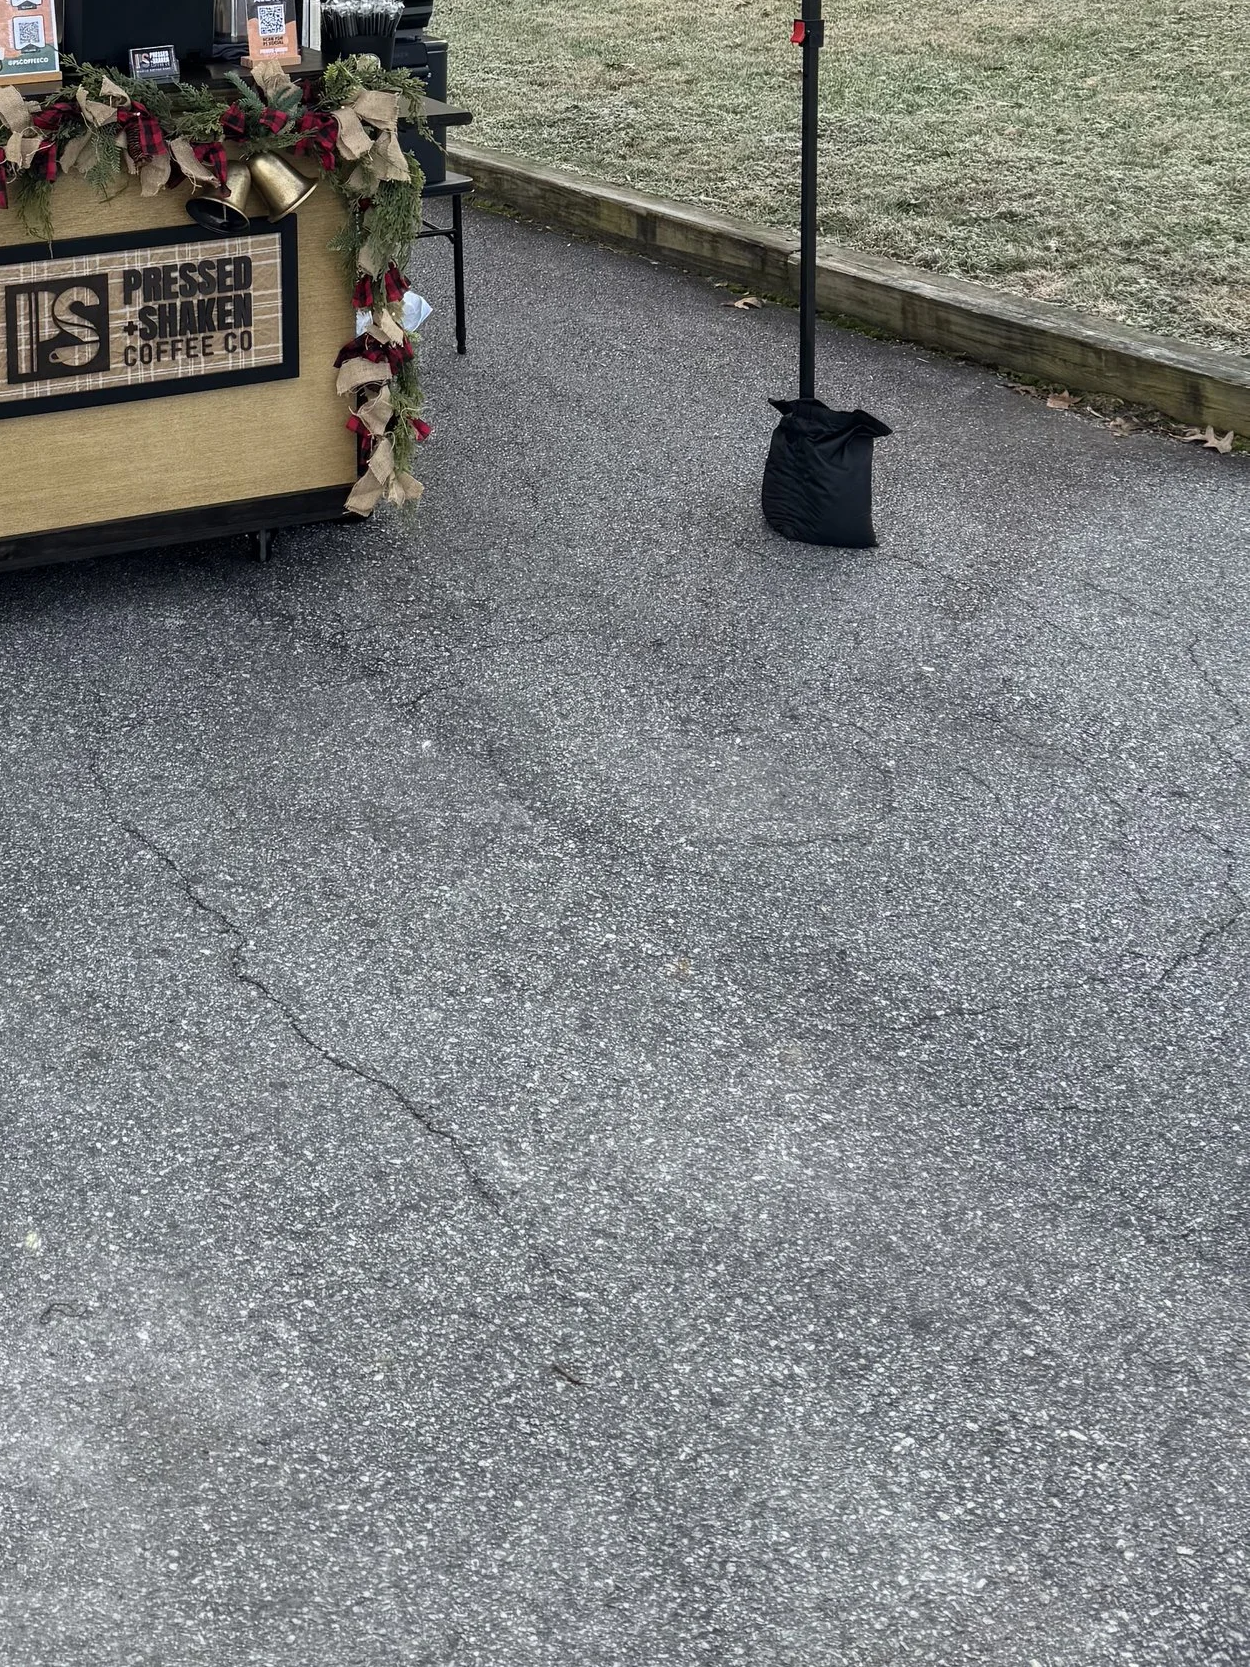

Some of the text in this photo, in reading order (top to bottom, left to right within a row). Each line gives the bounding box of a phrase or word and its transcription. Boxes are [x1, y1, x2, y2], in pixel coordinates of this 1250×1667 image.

[8, 57, 49, 66] @PSCOFFEECO
[123, 256, 253, 305] PRESSED
[124, 330, 253, 367] COFFEE CO
